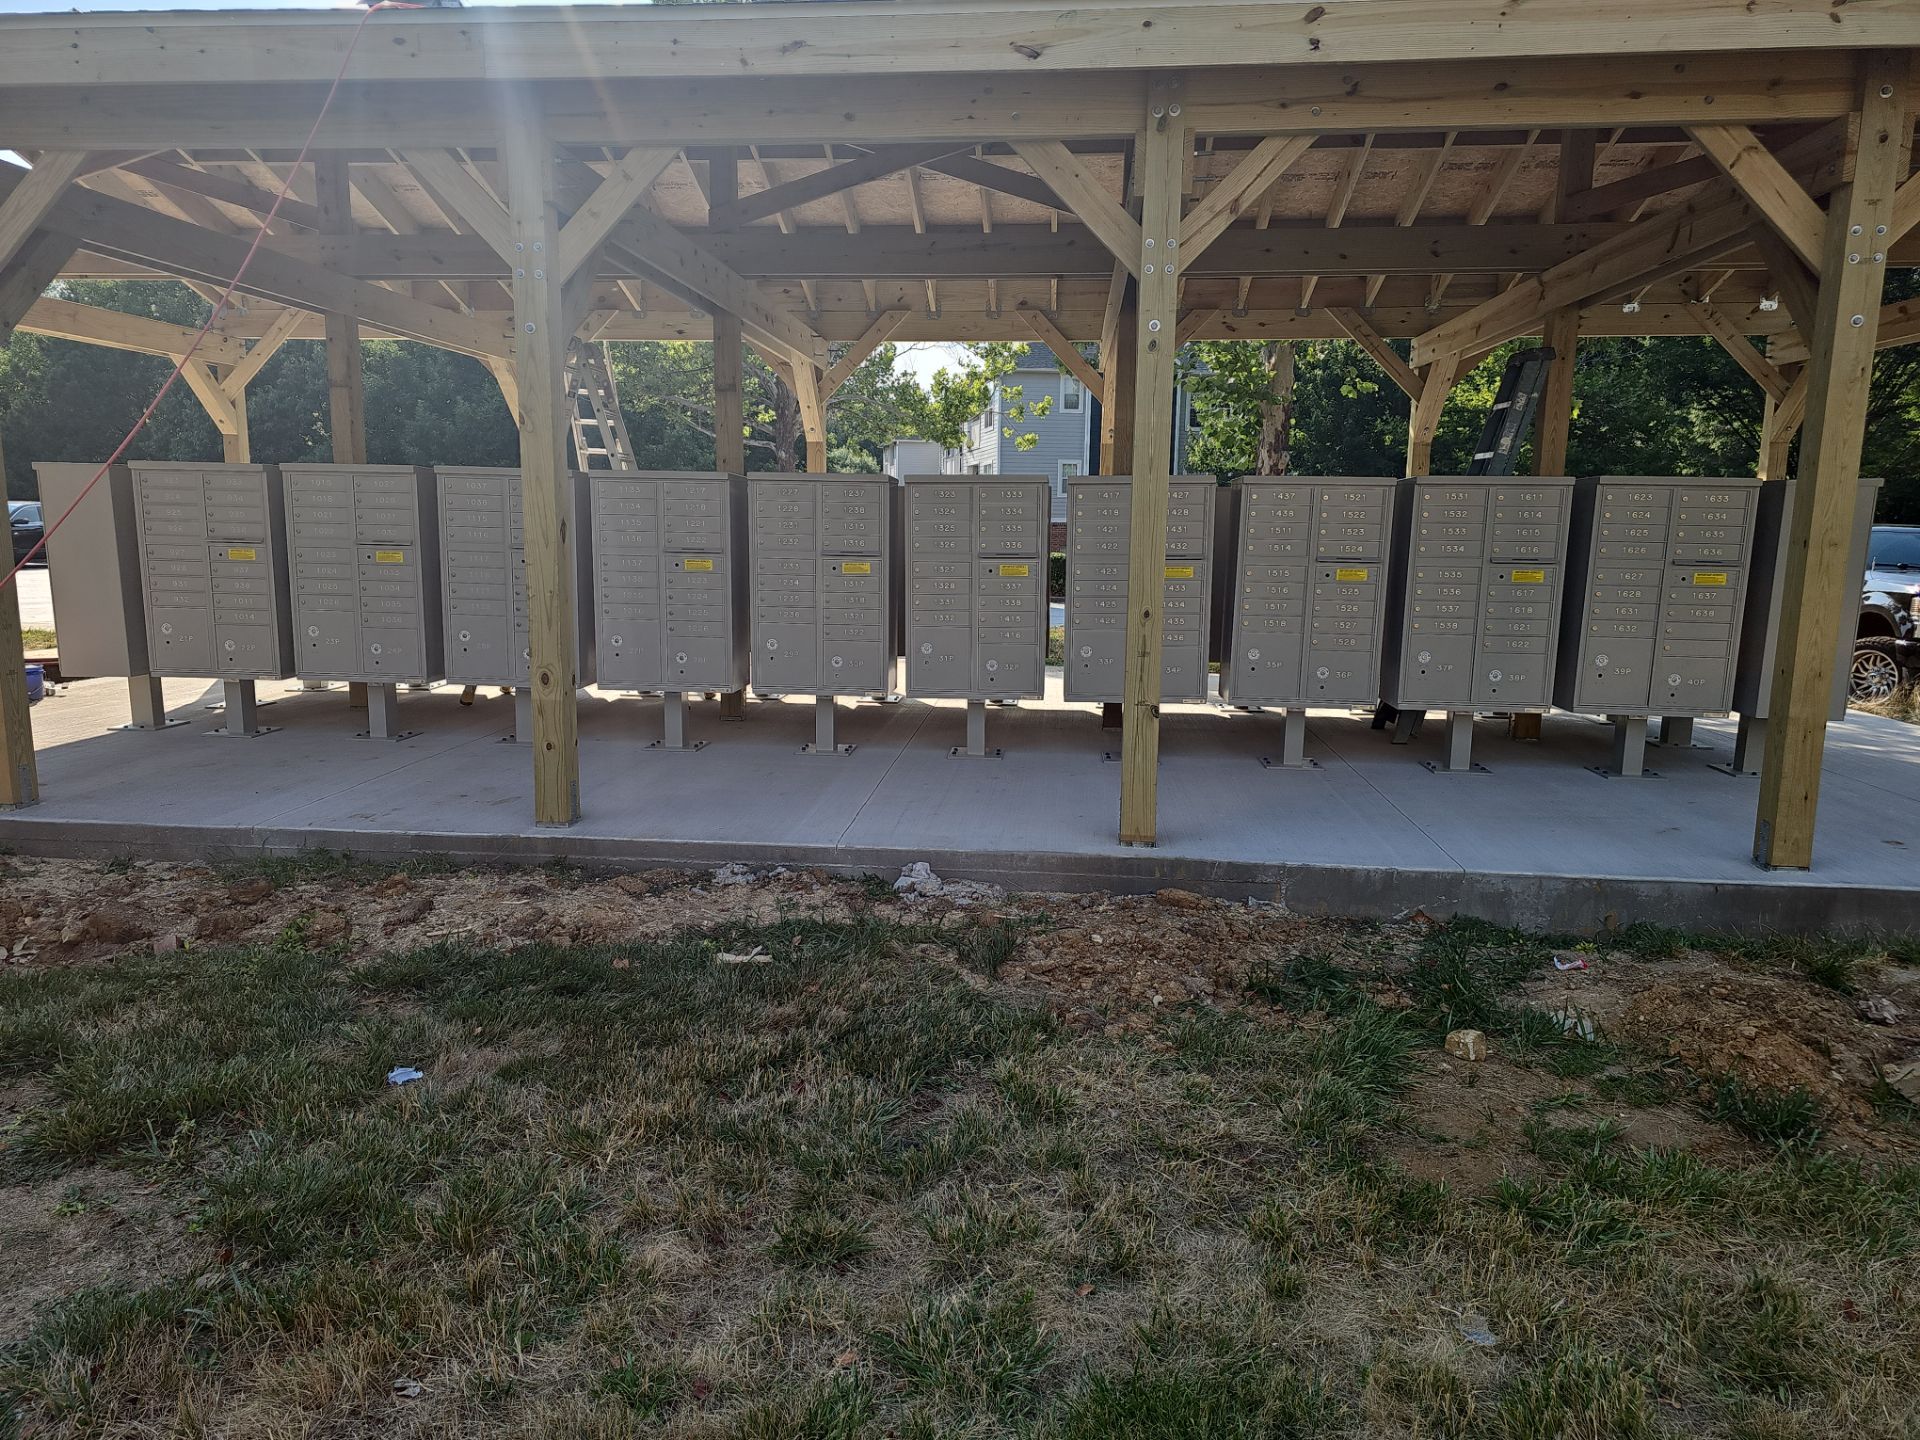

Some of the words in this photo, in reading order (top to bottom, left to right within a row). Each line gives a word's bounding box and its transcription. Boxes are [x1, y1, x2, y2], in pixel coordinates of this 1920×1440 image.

[1097, 491, 1120, 499] 1417
[1167, 491, 1189, 499] 1427
[1273, 492, 1296, 500] 1437
[1167, 508, 1189, 516] 1428
[1343, 511, 1366, 519] 1522
[1444, 510, 1468, 518] 1532
[1518, 511, 1542, 519] 1614
[1626, 511, 1651, 519] 1624
[934, 524, 956, 532] 1325
[1097, 525, 1118, 533] 1421
[1342, 528, 1364, 536] 1523
[1442, 527, 1466, 535] 1533
[778, 537, 799, 545] 1232
[934, 541, 956, 549] 1326
[1001, 541, 1023, 549] 1336
[1165, 542, 1188, 550] 1432
[1340, 545, 1363, 553] 1524
[1441, 544, 1464, 552] 1534
[1698, 548, 1723, 556] 1636
[1620, 572, 1643, 580] 1627
[843, 580, 865, 588] 1317
[1000, 583, 1022, 591] 1337
[1164, 584, 1186, 592] 1433
[1267, 586, 1289, 594] 1516
[1437, 588, 1461, 596] 1536
[1617, 590, 1641, 598] 1628
[1265, 602, 1287, 610] 1517
[1336, 604, 1359, 612] 1526
[1436, 605, 1460, 613] 1537
[1690, 609, 1715, 617] 1638
[1000, 615, 1021, 623] 1415
[1163, 617, 1185, 625] 1435
[1508, 623, 1531, 631] 1621
[1613, 625, 1637, 633] 1632
[843, 628, 864, 636] 1322
[1506, 640, 1529, 648] 1622
[1687, 678, 1705, 686] 40P
